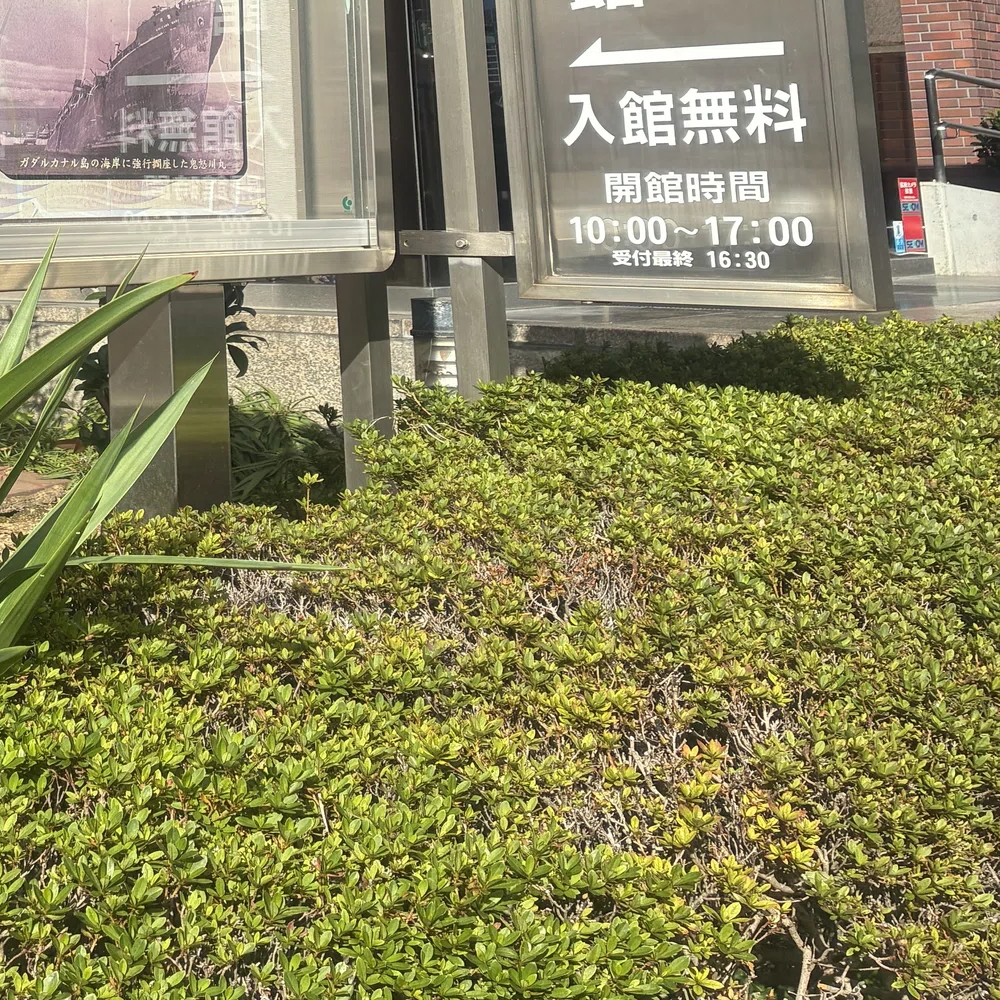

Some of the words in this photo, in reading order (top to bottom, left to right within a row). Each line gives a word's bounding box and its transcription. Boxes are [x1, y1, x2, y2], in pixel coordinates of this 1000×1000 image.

[562, 83, 807, 146] 入館無料
[604, 171, 770, 204] 開館時間
[612, 250, 694, 268] 受付最終
[707, 251, 770, 269] 16:30
